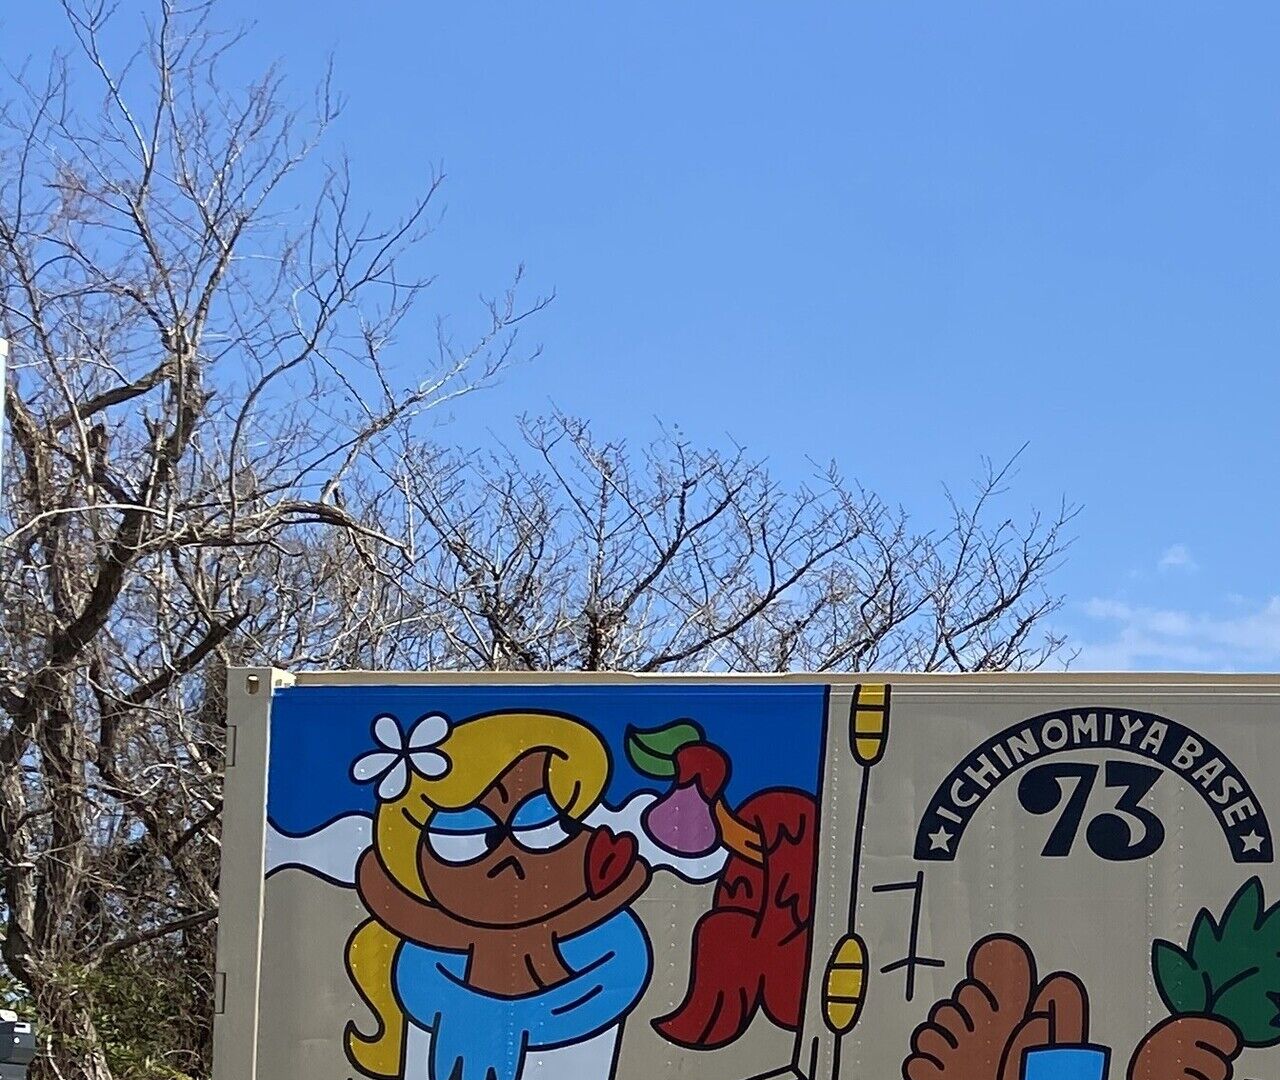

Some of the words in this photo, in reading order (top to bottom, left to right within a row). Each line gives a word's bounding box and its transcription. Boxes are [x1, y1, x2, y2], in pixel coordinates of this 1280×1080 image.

[936, 713, 1169, 824] ICHINOMIYA
[1171, 735, 1257, 827] BASE
[1017, 760, 1166, 862] 73
